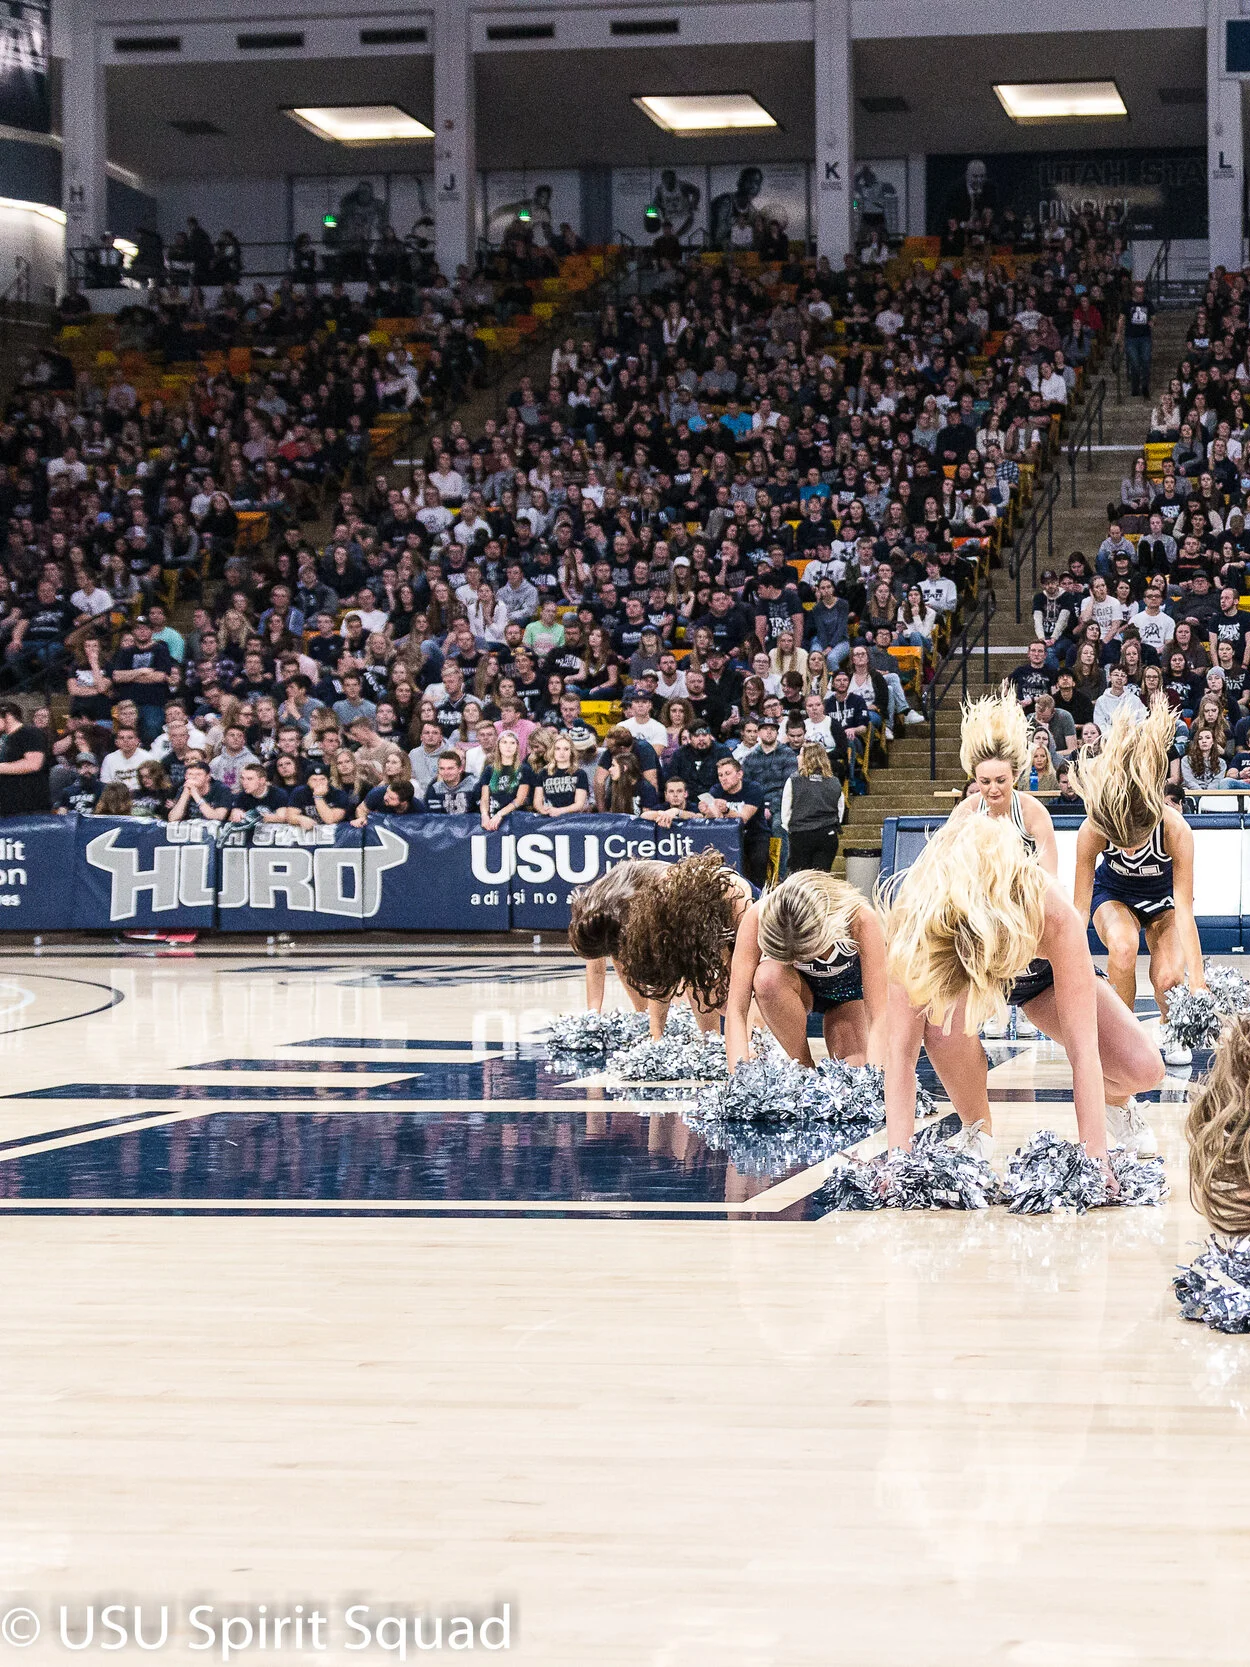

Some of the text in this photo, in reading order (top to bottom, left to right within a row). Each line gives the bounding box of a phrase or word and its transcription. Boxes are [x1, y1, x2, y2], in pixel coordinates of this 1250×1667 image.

[1219, 150, 1232, 169] L
[825, 161, 841, 180] K
[443, 173, 456, 191] J
[70, 184, 84, 203] H
[603, 834, 694, 858] Credit
[470, 833, 600, 885] USU
